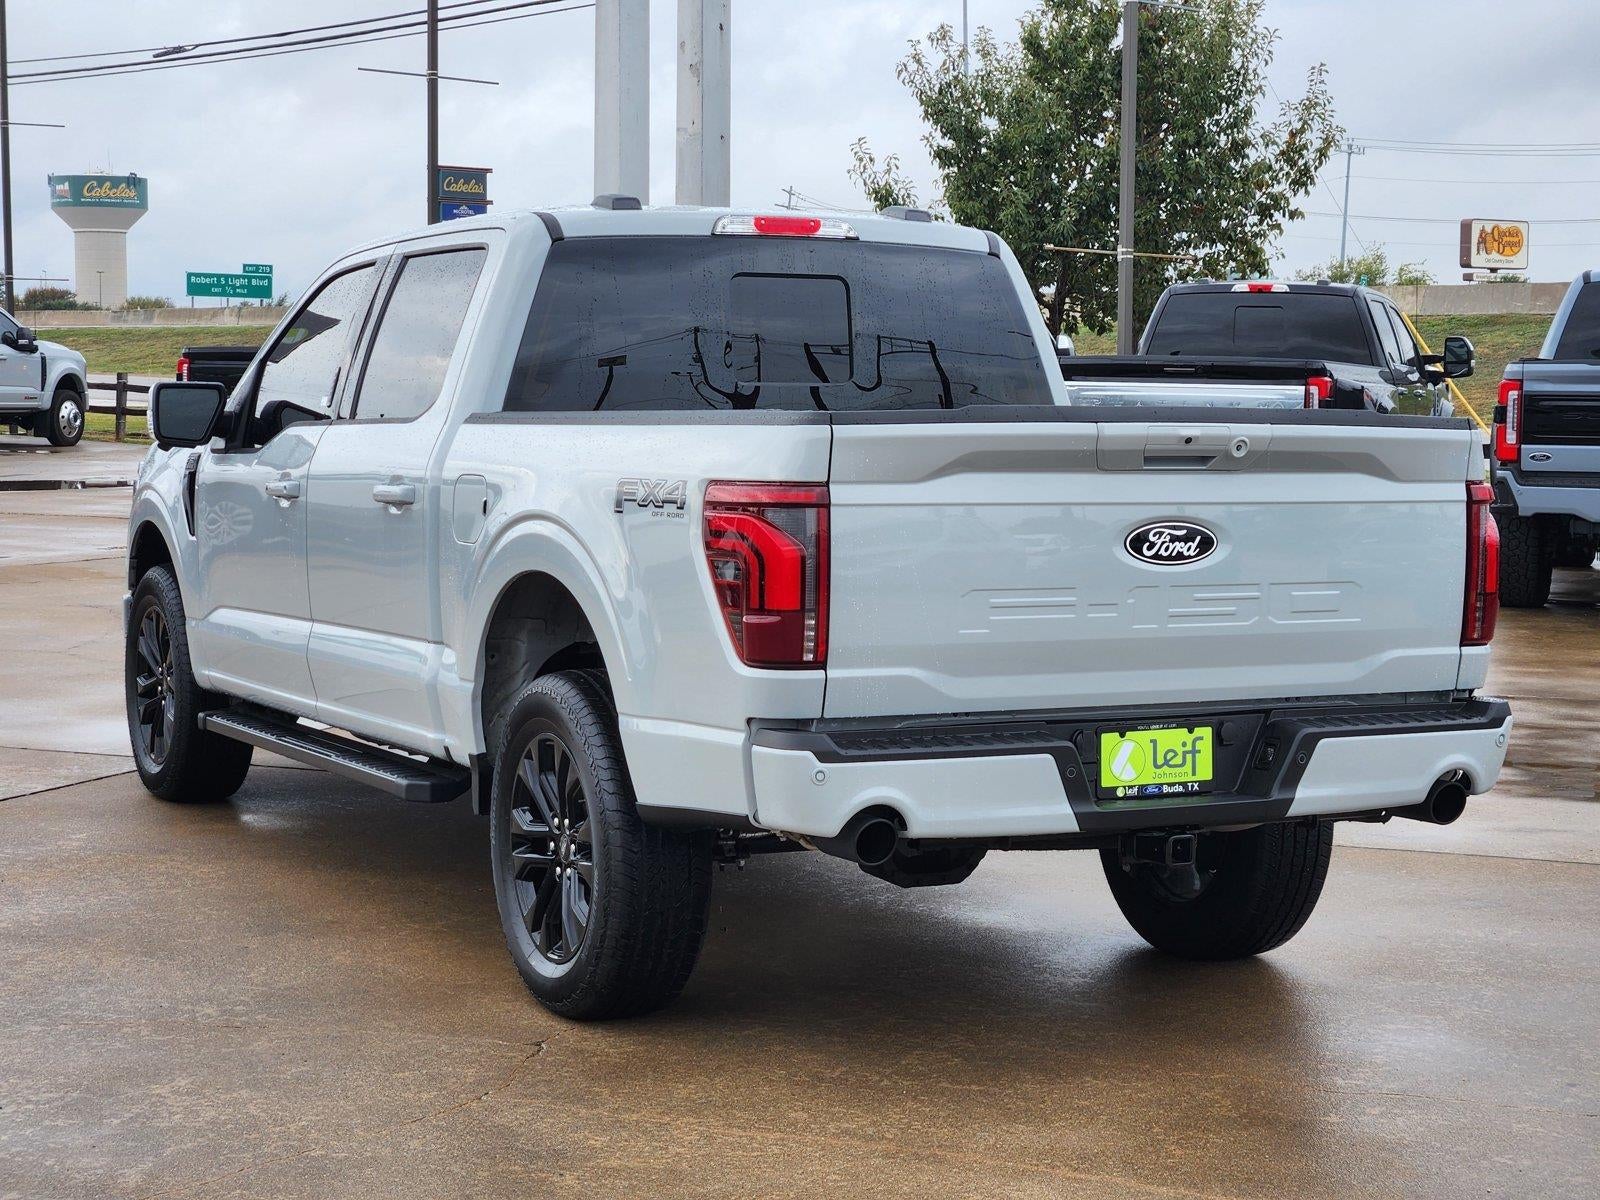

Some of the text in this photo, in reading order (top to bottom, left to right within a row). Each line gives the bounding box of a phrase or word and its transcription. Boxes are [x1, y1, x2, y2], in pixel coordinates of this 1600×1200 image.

[1492, 225, 1520, 241] Cracker
[1498, 238, 1521, 254] Barrel
[190, 275, 269, 287] Robert S Light Blvd
[614, 477, 688, 514] FX4
[1142, 527, 1202, 557] Ford
[958, 581, 1363, 635] F-150
[1149, 735, 1204, 777] leif
[1152, 771, 1189, 780] Johnson
[1125, 785, 1139, 796] leif
[1162, 784, 1185, 793] Buda,
[1187, 782, 1200, 791] TX
